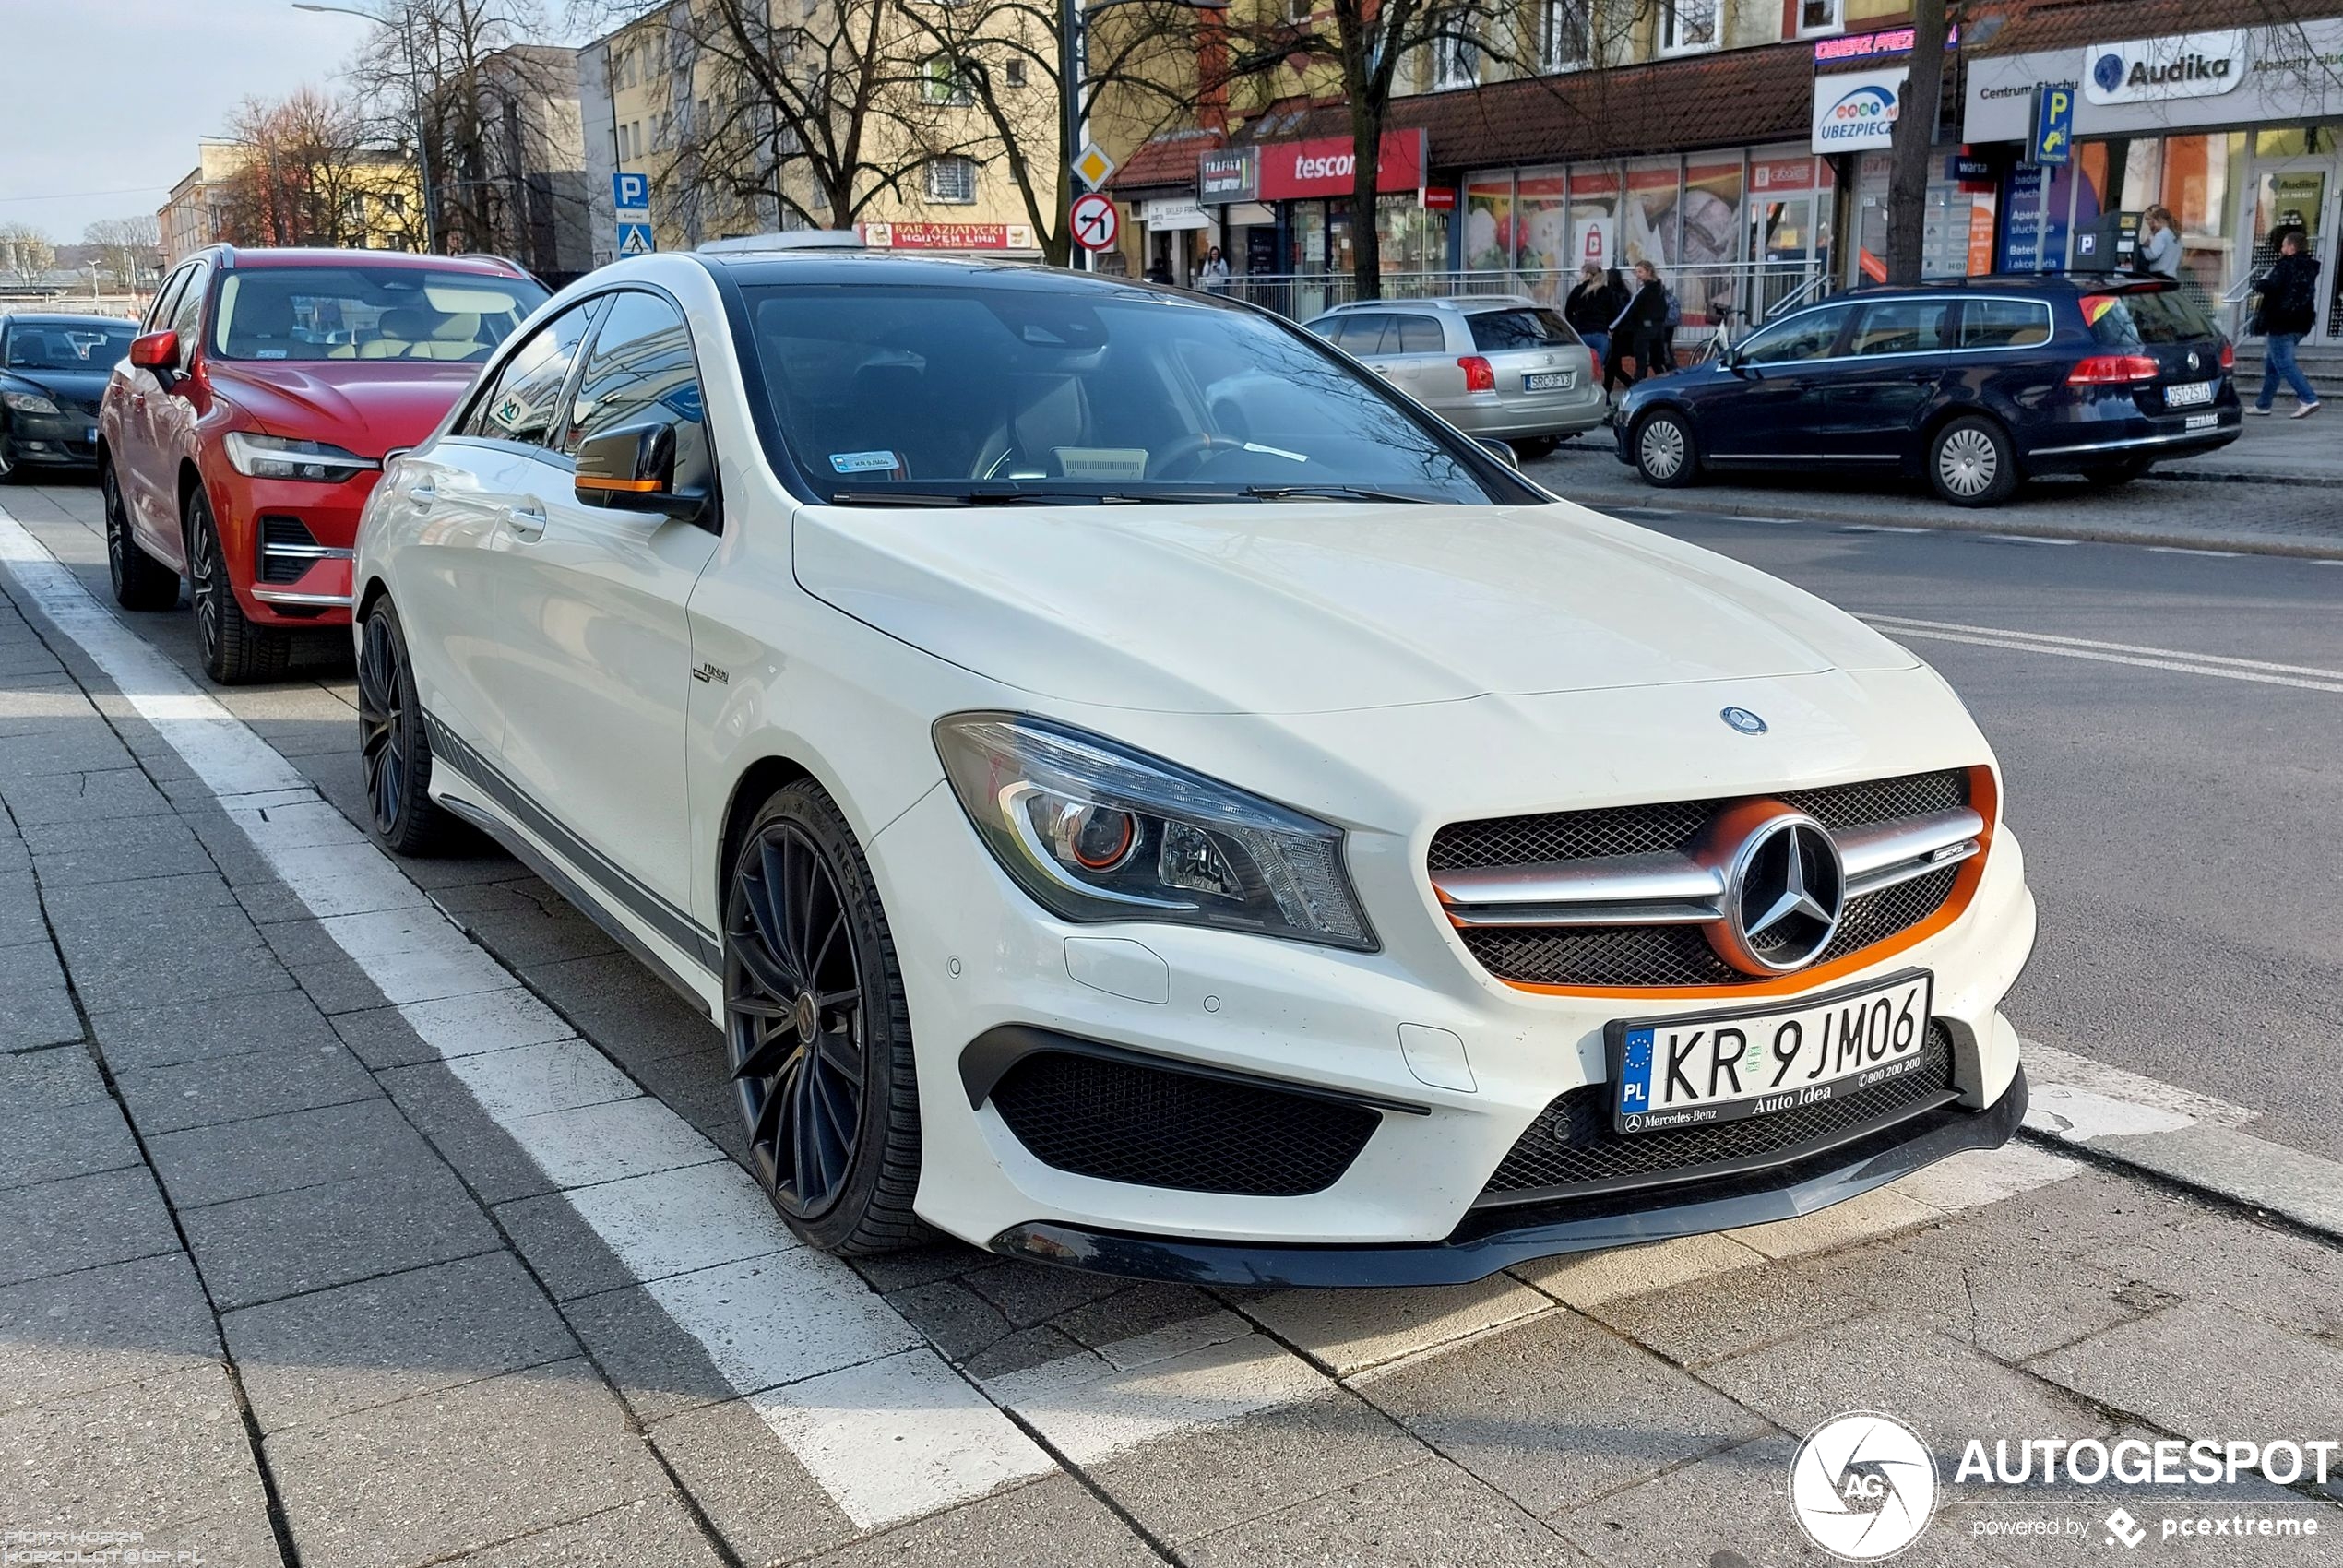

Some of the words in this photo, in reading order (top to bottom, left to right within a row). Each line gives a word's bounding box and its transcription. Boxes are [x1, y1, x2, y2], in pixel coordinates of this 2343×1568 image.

[1873, 29, 1915, 53] PREZ
[2126, 53, 2230, 87] Audika
[1980, 86, 2031, 100] Centrum
[1885, 106, 1898, 120] M
[2050, 93, 2067, 125] P
[1821, 121, 1893, 139] UBEZPIECZ
[622, 177, 641, 204] P
[930, 224, 1004, 236] AZJATYCKI
[2081, 235, 2093, 253] P
[1664, 1028, 1747, 1103] KR
[1769, 988, 1918, 1088] 9JM06
[1868, 1069, 1885, 1084] 800
[1886, 1063, 1903, 1076] 200
[1905, 1057, 1921, 1071] 200
[1623, 1082, 1646, 1102] PL
[1752, 1096, 1793, 1115] Auto
[1798, 1087, 1831, 1106] Idea
[1644, 1110, 1717, 1128] Mercedes-Benz
